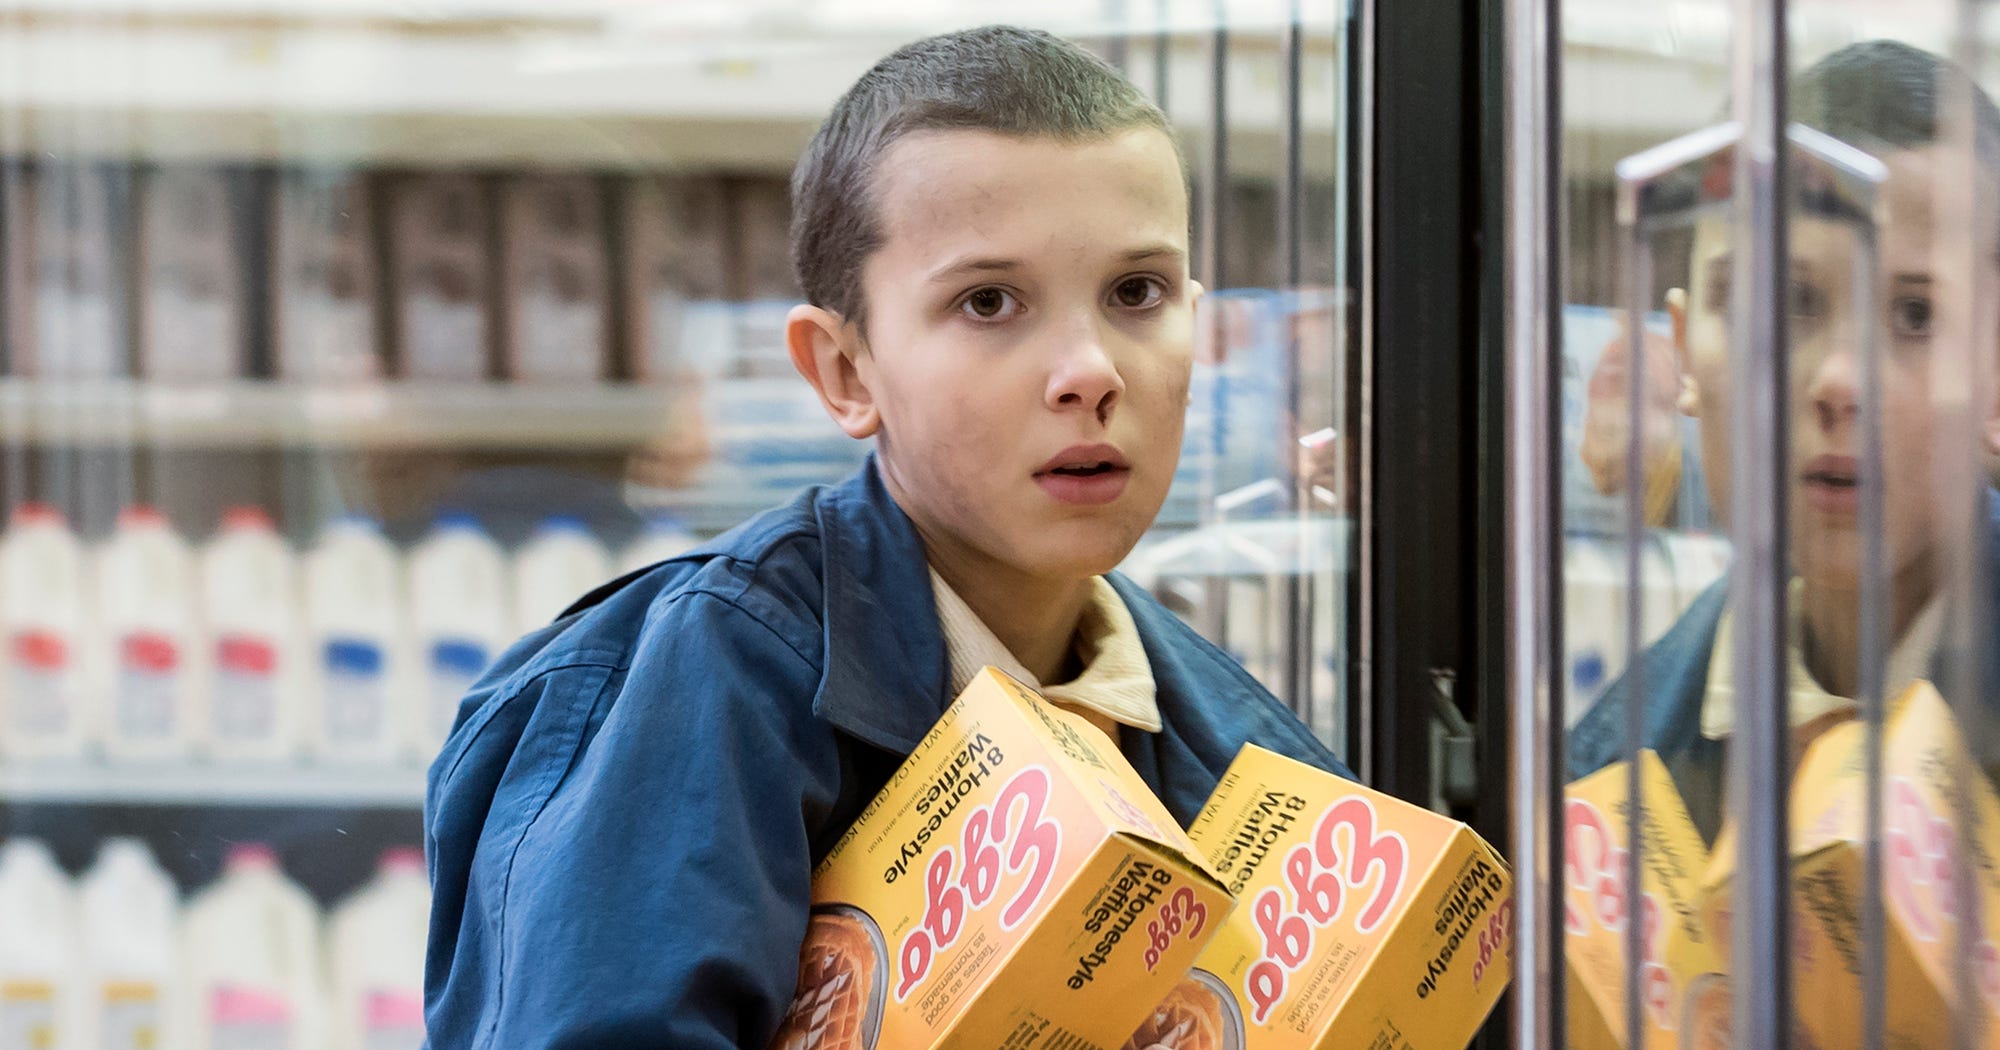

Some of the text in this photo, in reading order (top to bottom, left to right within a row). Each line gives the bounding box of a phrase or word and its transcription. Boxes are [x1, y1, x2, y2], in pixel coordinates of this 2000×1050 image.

[898, 783, 928, 817] Vitamins
[915, 733, 992, 815] Waffles
[935, 756, 950, 774] with
[867, 837, 883, 854] Iron
[884, 746, 1004, 884] 8 Homestyle
[884, 818, 897, 836] and
[1216, 792, 1286, 873] Waffles
[1229, 796, 1306, 894] 8 Homes
[896, 766, 1060, 1001] Eggo
[1085, 861, 1154, 934] Waffles
[1152, 869, 1171, 885] 8
[1247, 797, 1405, 1023] Eggo
[1435, 860, 1491, 936] Waffles
[973, 933, 986, 949] as
[1067, 883, 1162, 990] Homestyle
[1144, 886, 1206, 972] Eggo
[1331, 942, 1344, 957] as
[1417, 873, 1503, 999] 8 Homestyle
[925, 995, 950, 1026] good
[950, 980, 963, 994] as
[1296, 1002, 1319, 1033] good
